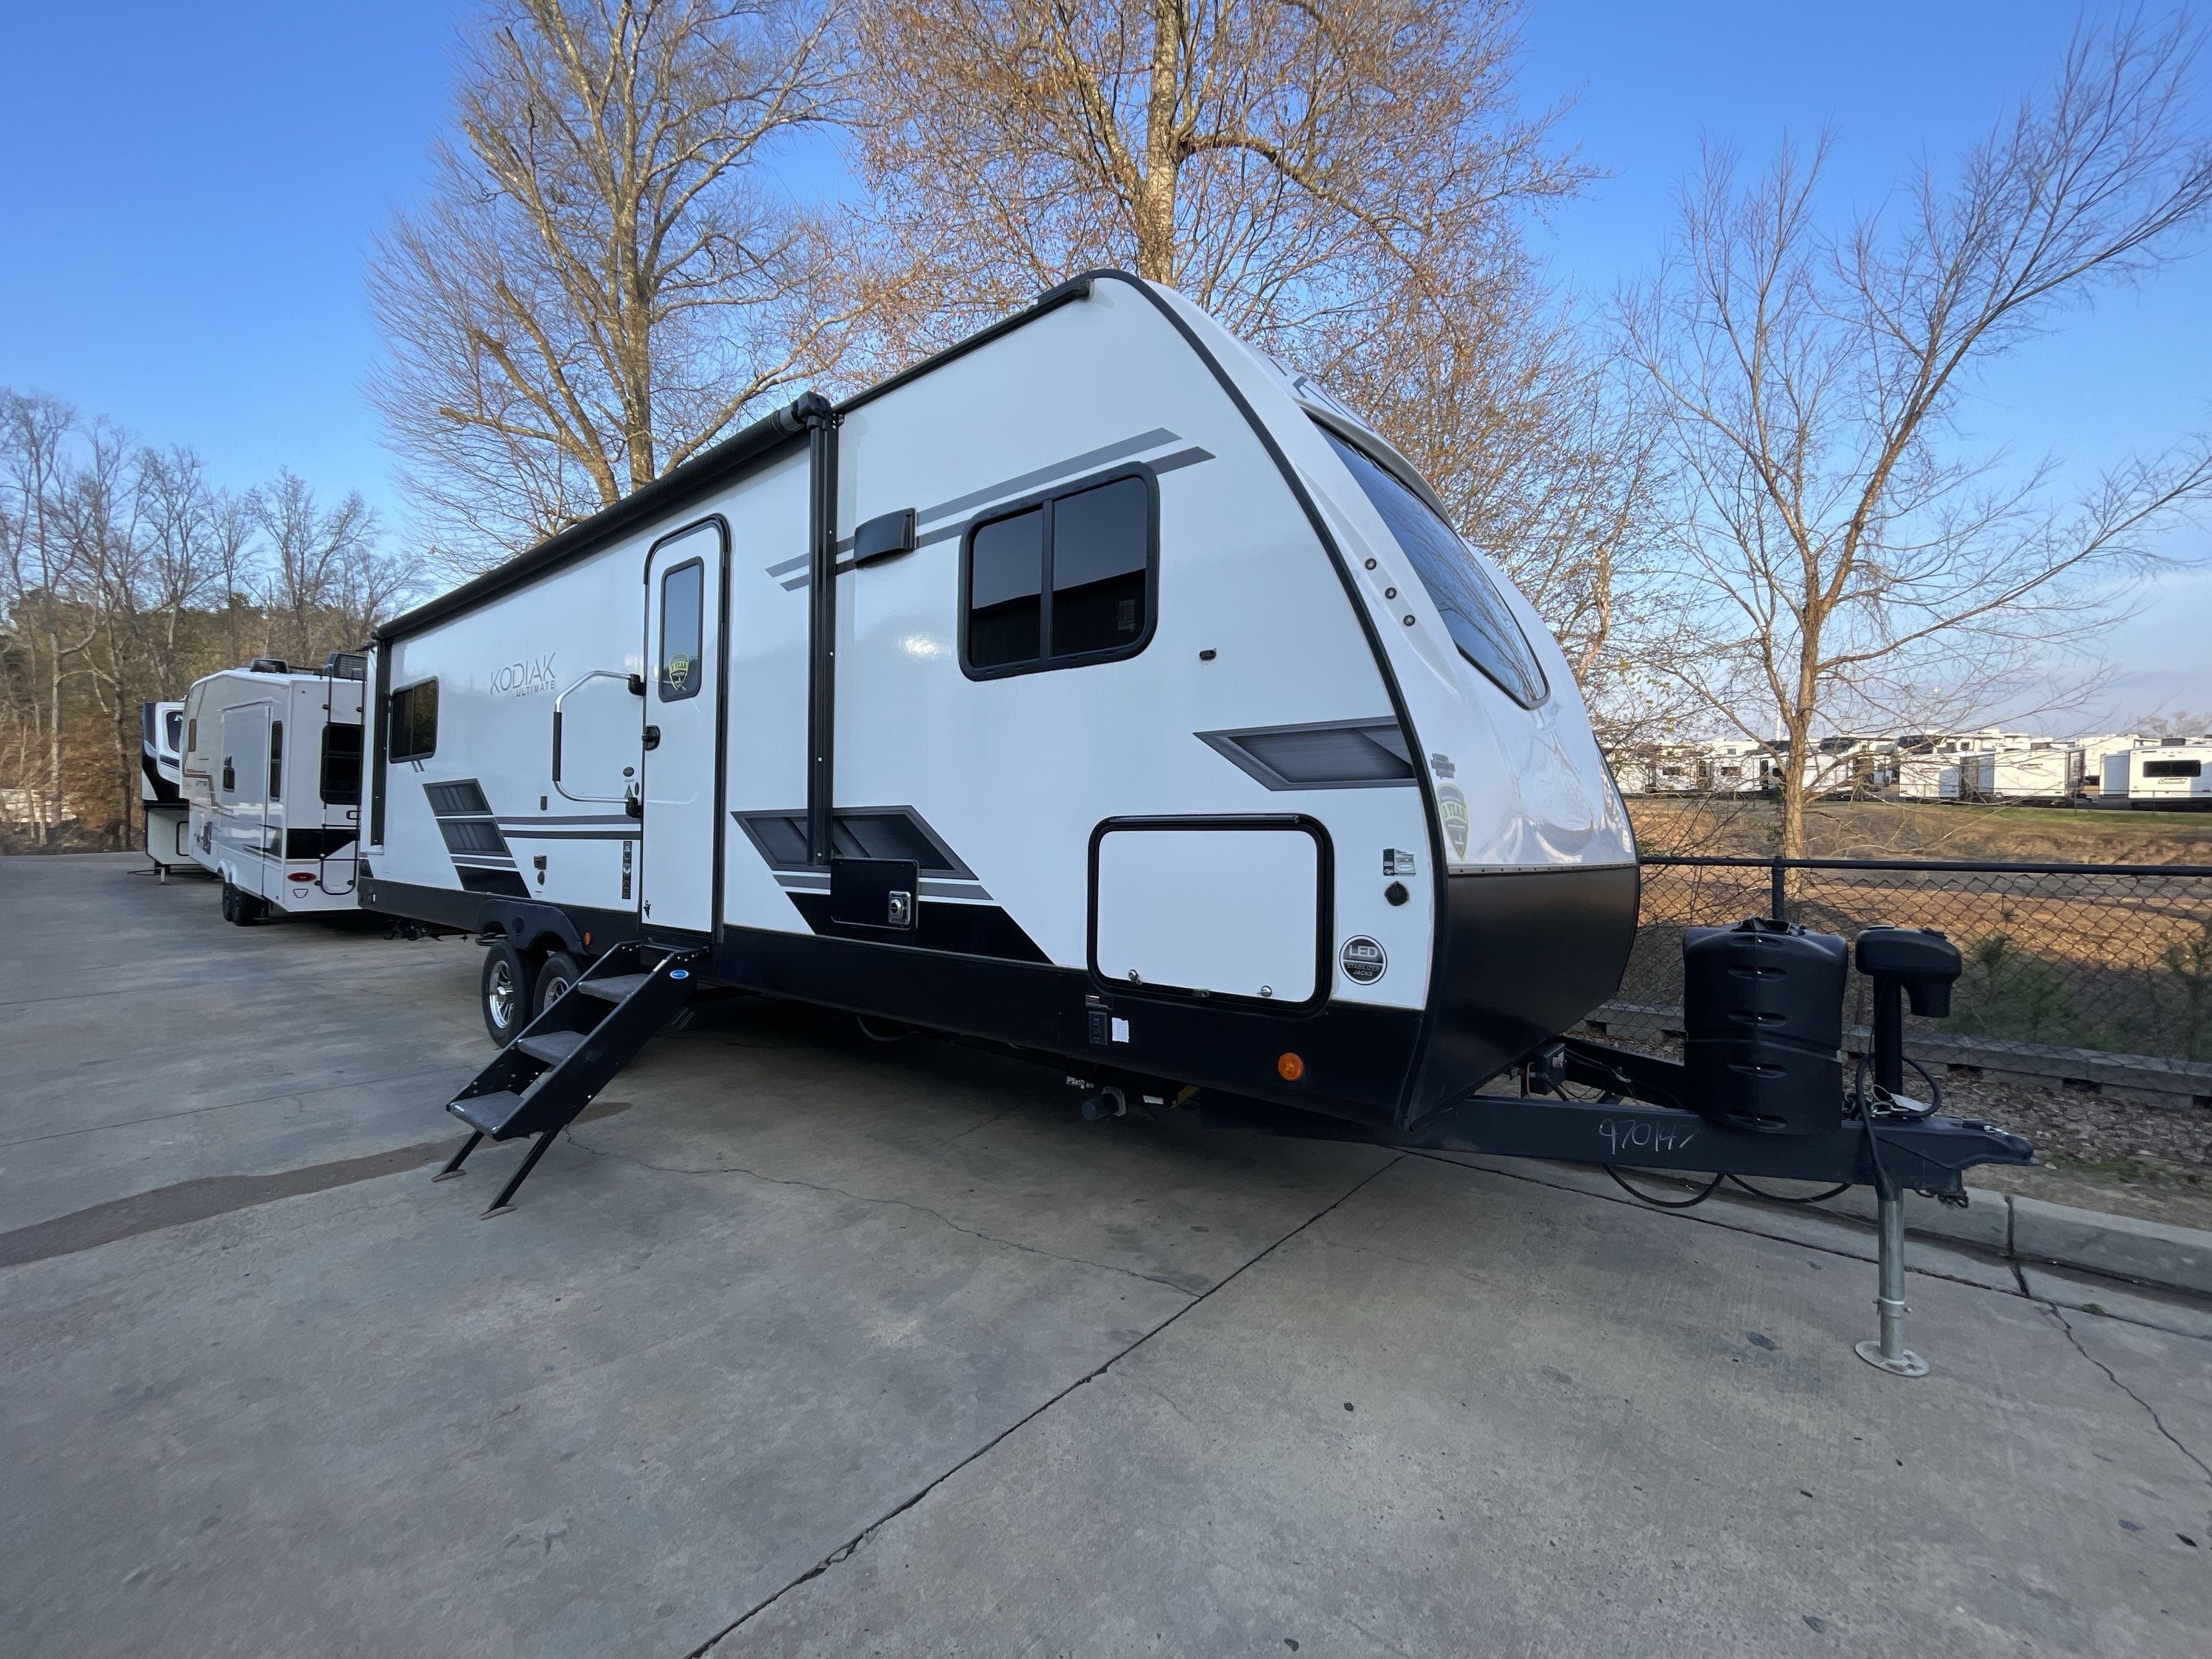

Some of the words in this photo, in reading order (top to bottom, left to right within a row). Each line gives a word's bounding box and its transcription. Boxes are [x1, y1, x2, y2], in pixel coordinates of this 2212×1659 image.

[490, 652, 557, 695] KODIAK
[516, 680, 555, 697] ULTIMATE
[1349, 944, 1378, 958] LED
[1346, 962, 1380, 972] STABILIZER
[1599, 1117, 1700, 1155] 970147
